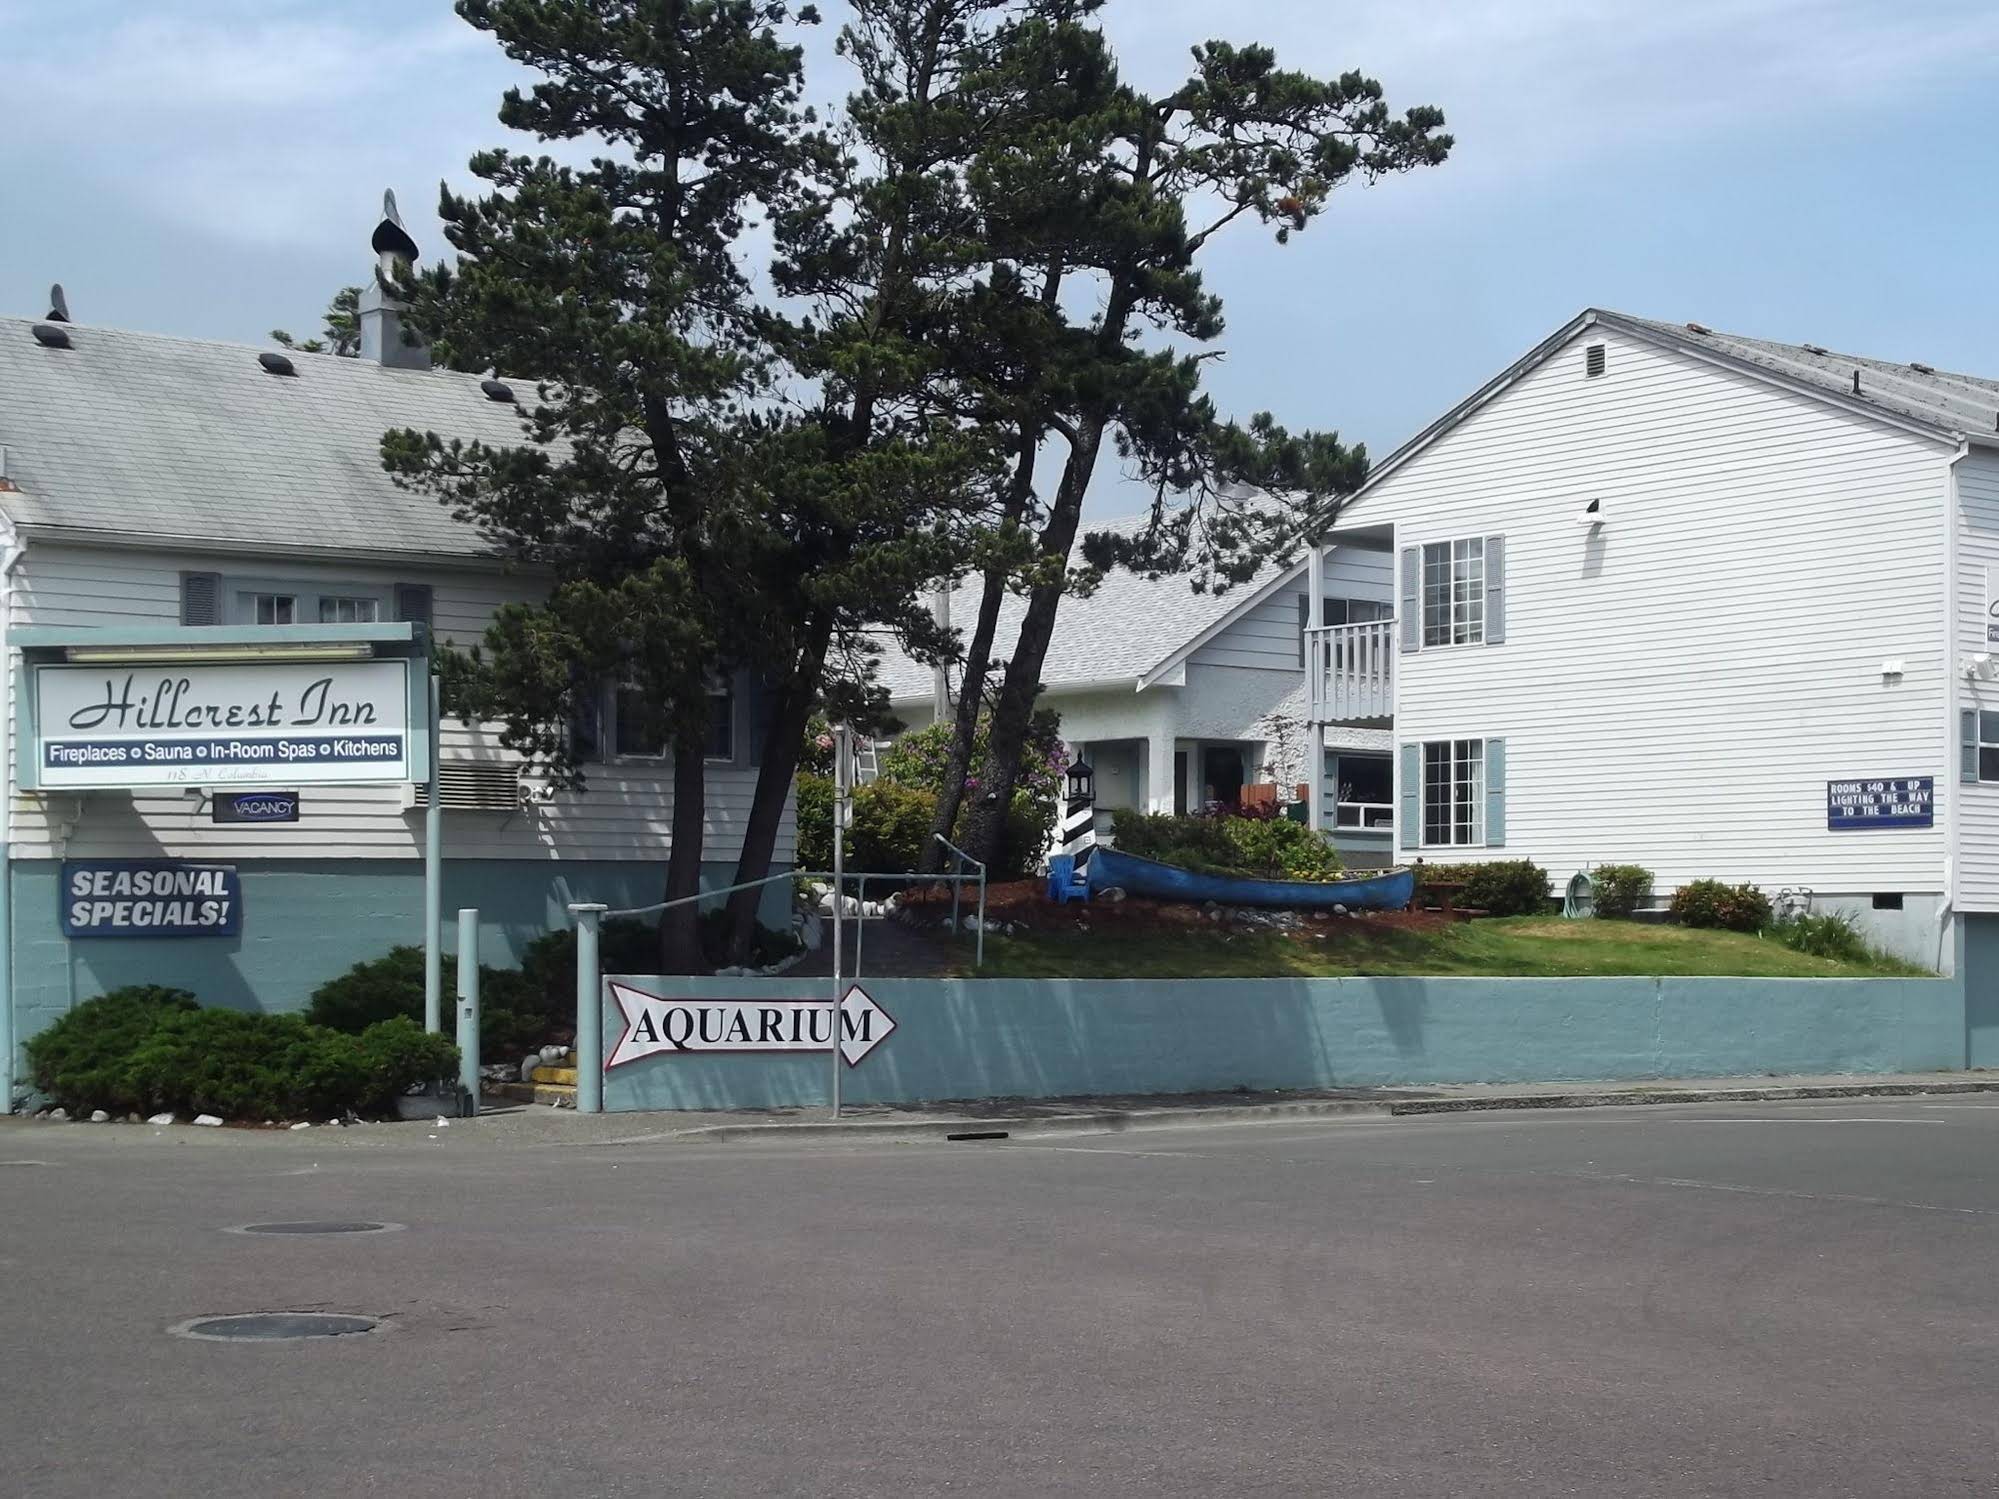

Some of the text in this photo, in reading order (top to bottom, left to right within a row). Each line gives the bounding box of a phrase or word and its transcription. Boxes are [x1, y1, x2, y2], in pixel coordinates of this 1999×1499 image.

[69, 673, 377, 730] Hillcrest Inn
[50, 739, 397, 764] Fireplaces Sauna In-Room Spas Kitchens
[1831, 783, 1862, 794] ROOMS
[1867, 783, 1884, 792] $40
[1907, 780, 1920, 790] UP
[1831, 791, 1929, 806] LIGHTING THE WAY
[234, 801, 295, 813] VACANCY
[1843, 804, 1921, 816] TO THE BEACH
[71, 871, 229, 896] SEASONAL
[70, 900, 229, 926] SPECIALS!
[630, 1007, 874, 1050] AQUARIUM
